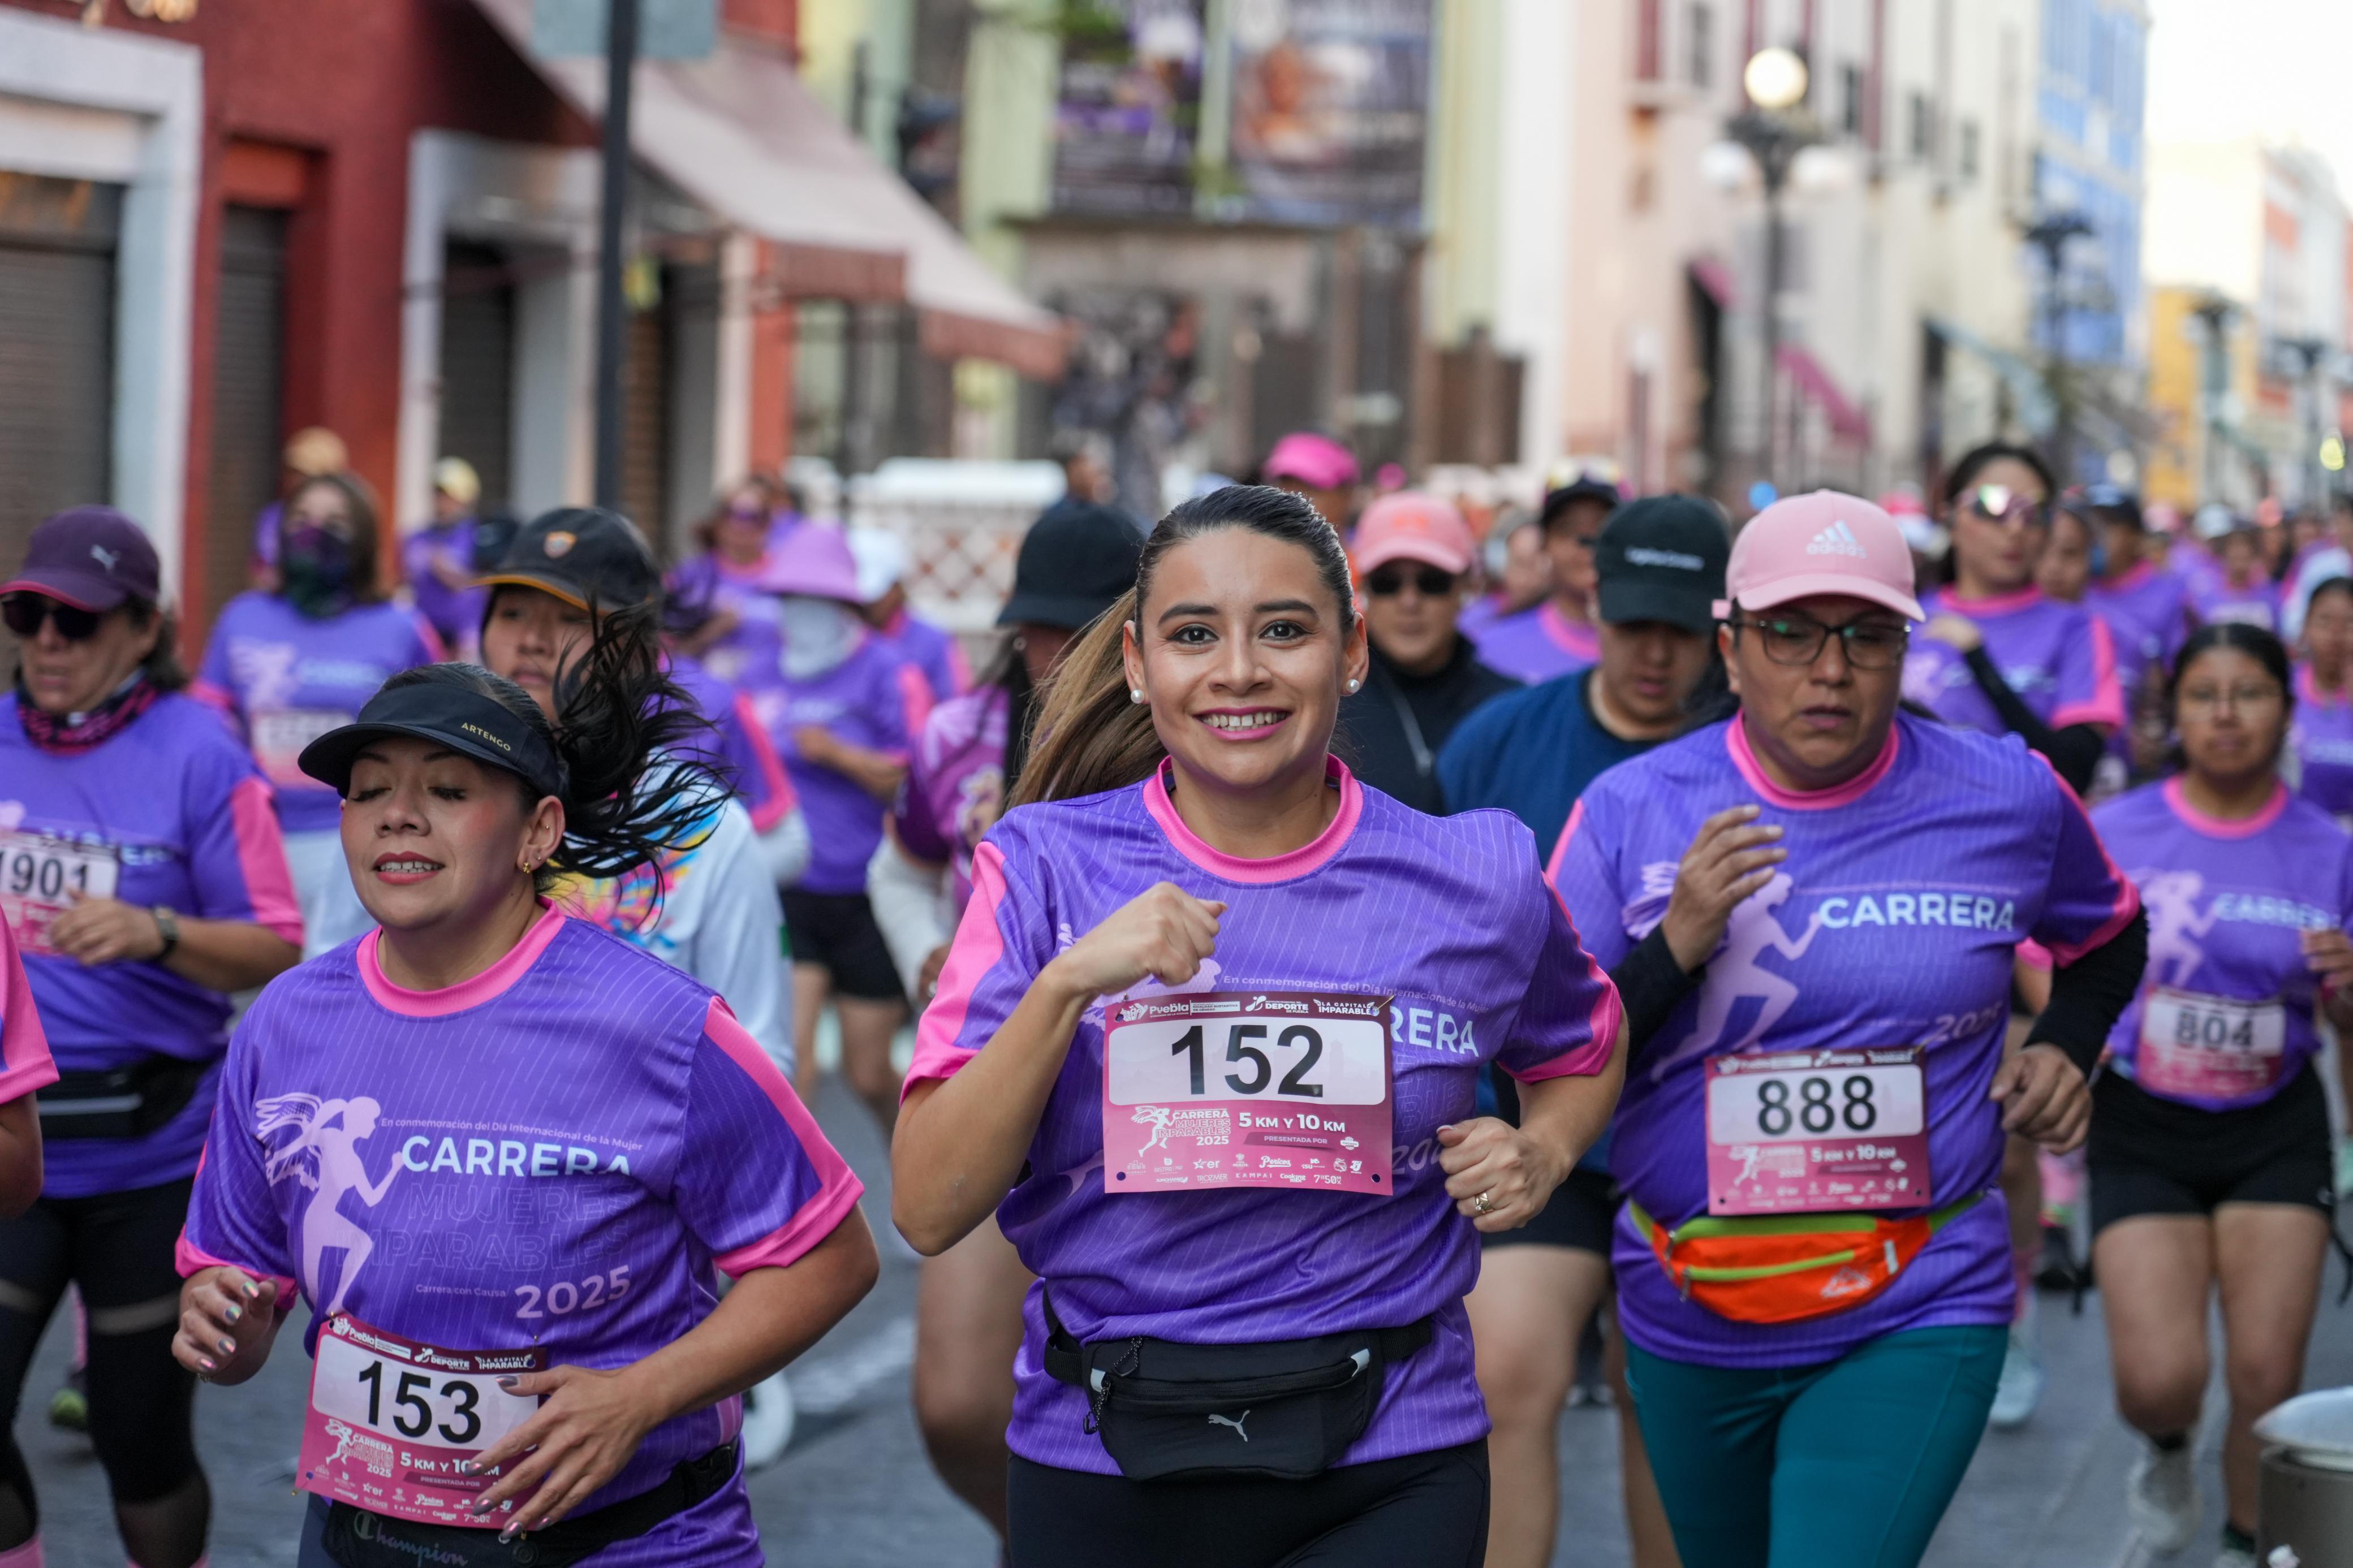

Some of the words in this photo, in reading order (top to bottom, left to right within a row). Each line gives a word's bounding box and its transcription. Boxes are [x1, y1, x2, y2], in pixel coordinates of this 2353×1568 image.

[1806, 542, 1868, 560] adidas
[460, 722, 511, 753] ARTENGO
[1818, 892, 2015, 932] CARRERA
[1223, 975, 1239, 984] En
[1242, 977, 1338, 990] conmemoración
[1341, 982, 1359, 991] del
[1383, 987, 1447, 1004] Internaciona
[1447, 997, 1457, 1007] de
[1458, 999, 1466, 1009] la
[1467, 1001, 1489, 1014] Mujer
[1149, 1003, 1189, 1015] Puebla
[1318, 1007, 1371, 1016] IMPARABLE
[2176, 1006, 2253, 1051] 804
[1171, 1024, 1324, 1098] 152
[1172, 1110, 1230, 1120] CARRERA
[1757, 1075, 1877, 1136] 888
[1156, 1126, 1231, 1138] IMPARABLES
[1175, 1118, 1231, 1128] MUJERES
[1238, 1112, 1252, 1128] 5
[1255, 1117, 1279, 1128] KM
[1283, 1117, 1294, 1129] Y
[1296, 1113, 1321, 1130] 10
[1323, 1121, 1346, 1133] KM
[381, 1118, 394, 1127] En
[395, 1119, 472, 1130] conmemoración
[475, 1122, 490, 1130] del
[509, 1124, 581, 1141] Internacional
[583, 1133, 597, 1143] de
[599, 1135, 610, 1145] la
[611, 1138, 643, 1151] Mujer
[1196, 1135, 1230, 1146] 2025
[402, 1135, 630, 1177] CARRERA
[1206, 1160, 1221, 1169] er
[1391, 1138, 1442, 1176] 20
[408, 1182, 636, 1224] MUJERES
[416, 1284, 452, 1294] Carrera
[453, 1286, 472, 1295] con
[473, 1287, 507, 1298] Causa
[514, 1264, 631, 1319] 2025
[430, 1358, 470, 1367] DEPORTE
[479, 1361, 528, 1370] IMPARABLE
[359, 1360, 481, 1444] 153
[353, 1433, 394, 1454] CARRERA
[367, 1463, 392, 1478] 2025
[400, 1452, 412, 1467] 5
[414, 1458, 435, 1471] KM
[439, 1462, 449, 1472] Y
[484, 1466, 499, 1475] M
[372, 1487, 383, 1496] er
[421, 1476, 464, 1486] PRESENTADA
[353, 1510, 468, 1568] Champion
